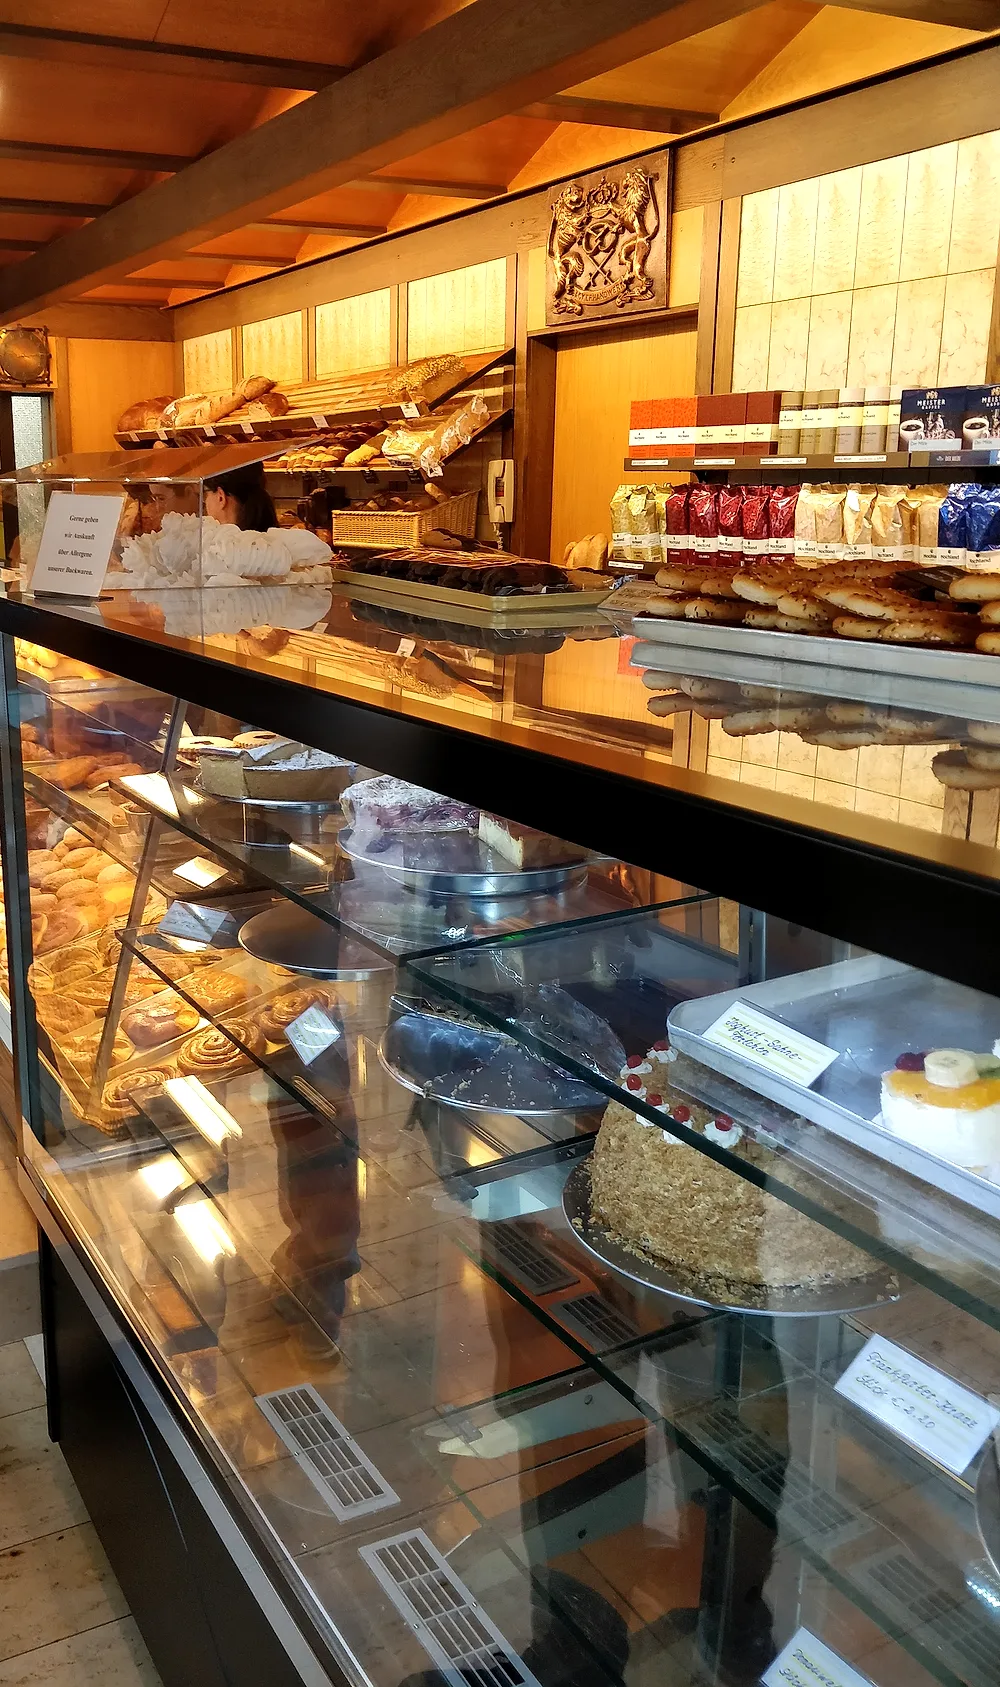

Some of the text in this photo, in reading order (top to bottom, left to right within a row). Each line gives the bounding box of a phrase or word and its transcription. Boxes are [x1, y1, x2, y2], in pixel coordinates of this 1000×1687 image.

[917, 398, 946, 407] MEISTER
[84, 516, 99, 524] geben
[70, 550, 93, 558] Allergene
[47, 565, 93, 576] unserer Backwaren.
[856, 1375, 888, 1398] Stück
[903, 1405, 936, 1429] 2.20
